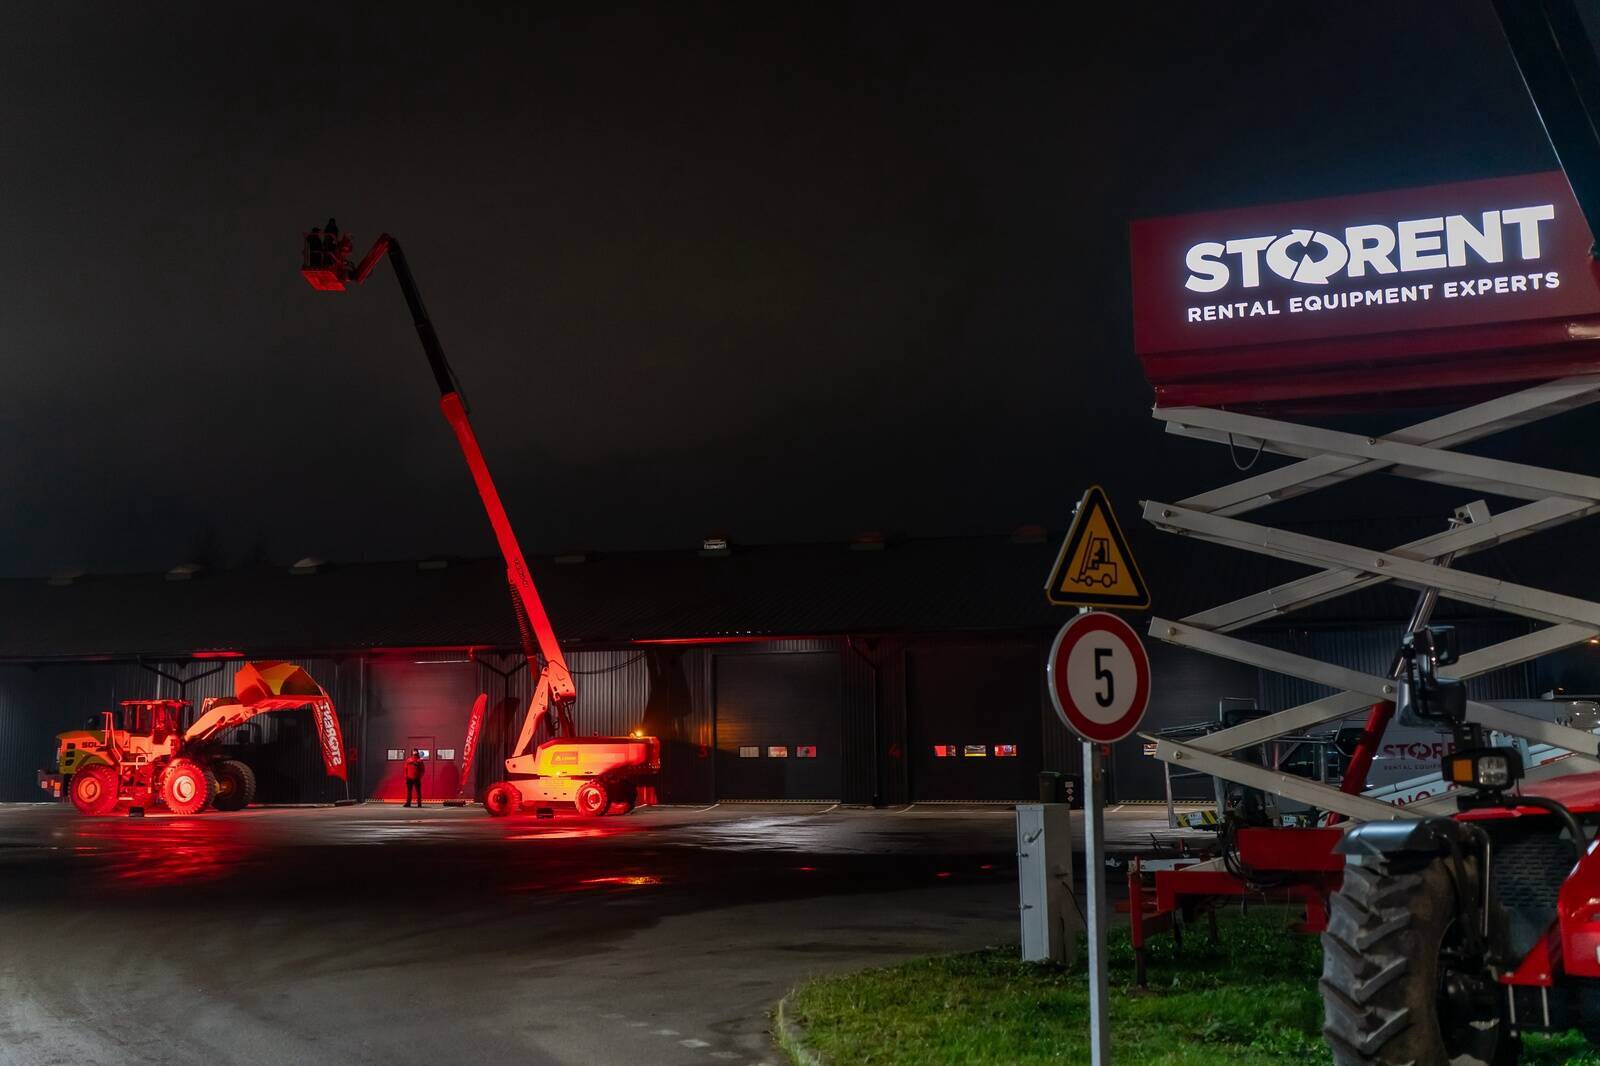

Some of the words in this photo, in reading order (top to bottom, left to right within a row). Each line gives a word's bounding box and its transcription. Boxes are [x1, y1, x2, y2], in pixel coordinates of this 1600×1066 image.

[1185, 204, 1554, 293] STORENT
[1188, 300, 1280, 322] RENTAL
[1290, 284, 1434, 313] EQUIPMENT
[1444, 271, 1560, 298] EXPERTS
[1094, 648, 1114, 707] 5
